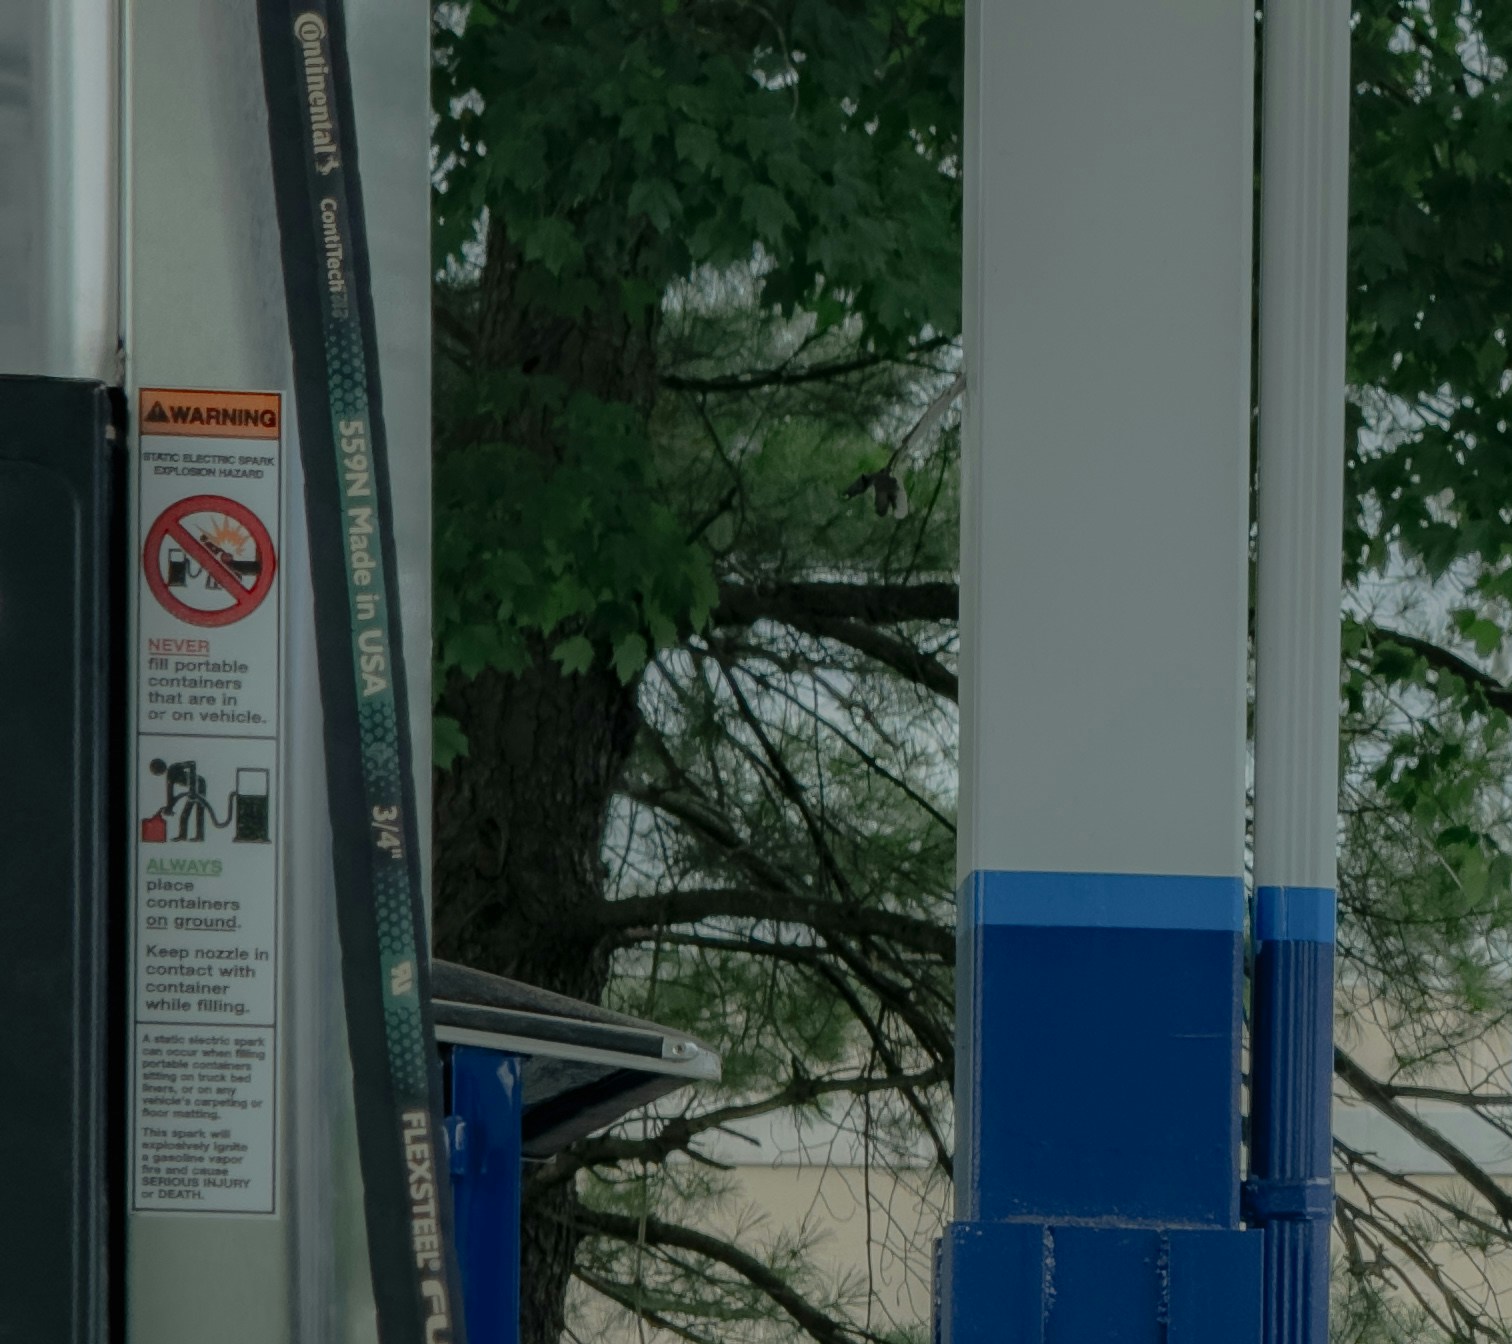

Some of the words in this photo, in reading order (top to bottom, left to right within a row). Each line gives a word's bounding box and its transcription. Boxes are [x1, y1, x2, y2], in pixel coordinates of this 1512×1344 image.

[294, 12, 337, 155] Continental
[169, 405, 277, 428] WARNING
[143, 452, 180, 462] STATIC
[183, 453, 236, 465] ELECTRIC
[238, 455, 275, 466] SPARK
[339, 419, 371, 497] 559N
[154, 465, 216, 477] EXPLOSION
[219, 467, 264, 479] HAZARD
[347, 506, 377, 586] Made
[356, 594, 380, 621] in
[148, 638, 209, 653] NEVER
[148, 658, 169, 671] fill
[175, 660, 249, 674] portable
[357, 629, 388, 697] USA
[148, 676, 242, 690] containers
[148, 691, 182, 705] that
[188, 694, 216, 706] are
[222, 693, 237, 706] in
[148, 711, 166, 721] or
[172, 711, 193, 721] on
[200, 710, 267, 724] vehicle.
[371, 804, 403, 859] 3/4"
[146, 858, 223, 874] ALWAYS
[146, 878, 194, 892] place
[146, 897, 240, 911] containers
[146, 916, 168, 926] on
[174, 915, 242, 930] ground.
[146, 944, 189, 960] Keep
[194, 948, 249, 960] nozzle
[255, 948, 269, 961] in
[145, 964, 213, 977] contact
[219, 965, 256, 978] with
[145, 982, 231, 994] container
[145, 999, 191, 1011] while
[198, 1000, 250, 1016] filling.
[142, 1034, 149, 1043] A
[188, 1036, 230, 1045] electric
[234, 1037, 265, 1047] spark
[165, 1049, 197, 1057] occur
[202, 1049, 232, 1058] when
[142, 1060, 189, 1069] portable
[192, 1061, 252, 1070] containers
[198, 1072, 226, 1082] truck
[230, 1073, 251, 1083] bed
[181, 1086, 194, 1094] or
[215, 1087, 236, 1096] any
[194, 1098, 247, 1109] carpeting
[250, 1100, 263, 1108] or
[142, 1127, 167, 1137] This
[171, 1128, 205, 1139] spark
[210, 1128, 231, 1138] will
[142, 1141, 210, 1152] explosively
[213, 1142, 248, 1153] ignite
[152, 1154, 205, 1164] gasoline
[208, 1156, 243, 1165] vapor
[142, 1165, 161, 1174] fire
[165, 1166, 188, 1175] and
[192, 1168, 229, 1176] cause
[142, 1177, 199, 1187] SERIOUS
[203, 1178, 250, 1188] INJURY
[141, 1190, 153, 1198] or
[158, 1189, 204, 1200] DEATH.
[402, 1112, 440, 1268] FLEXSTEEL
